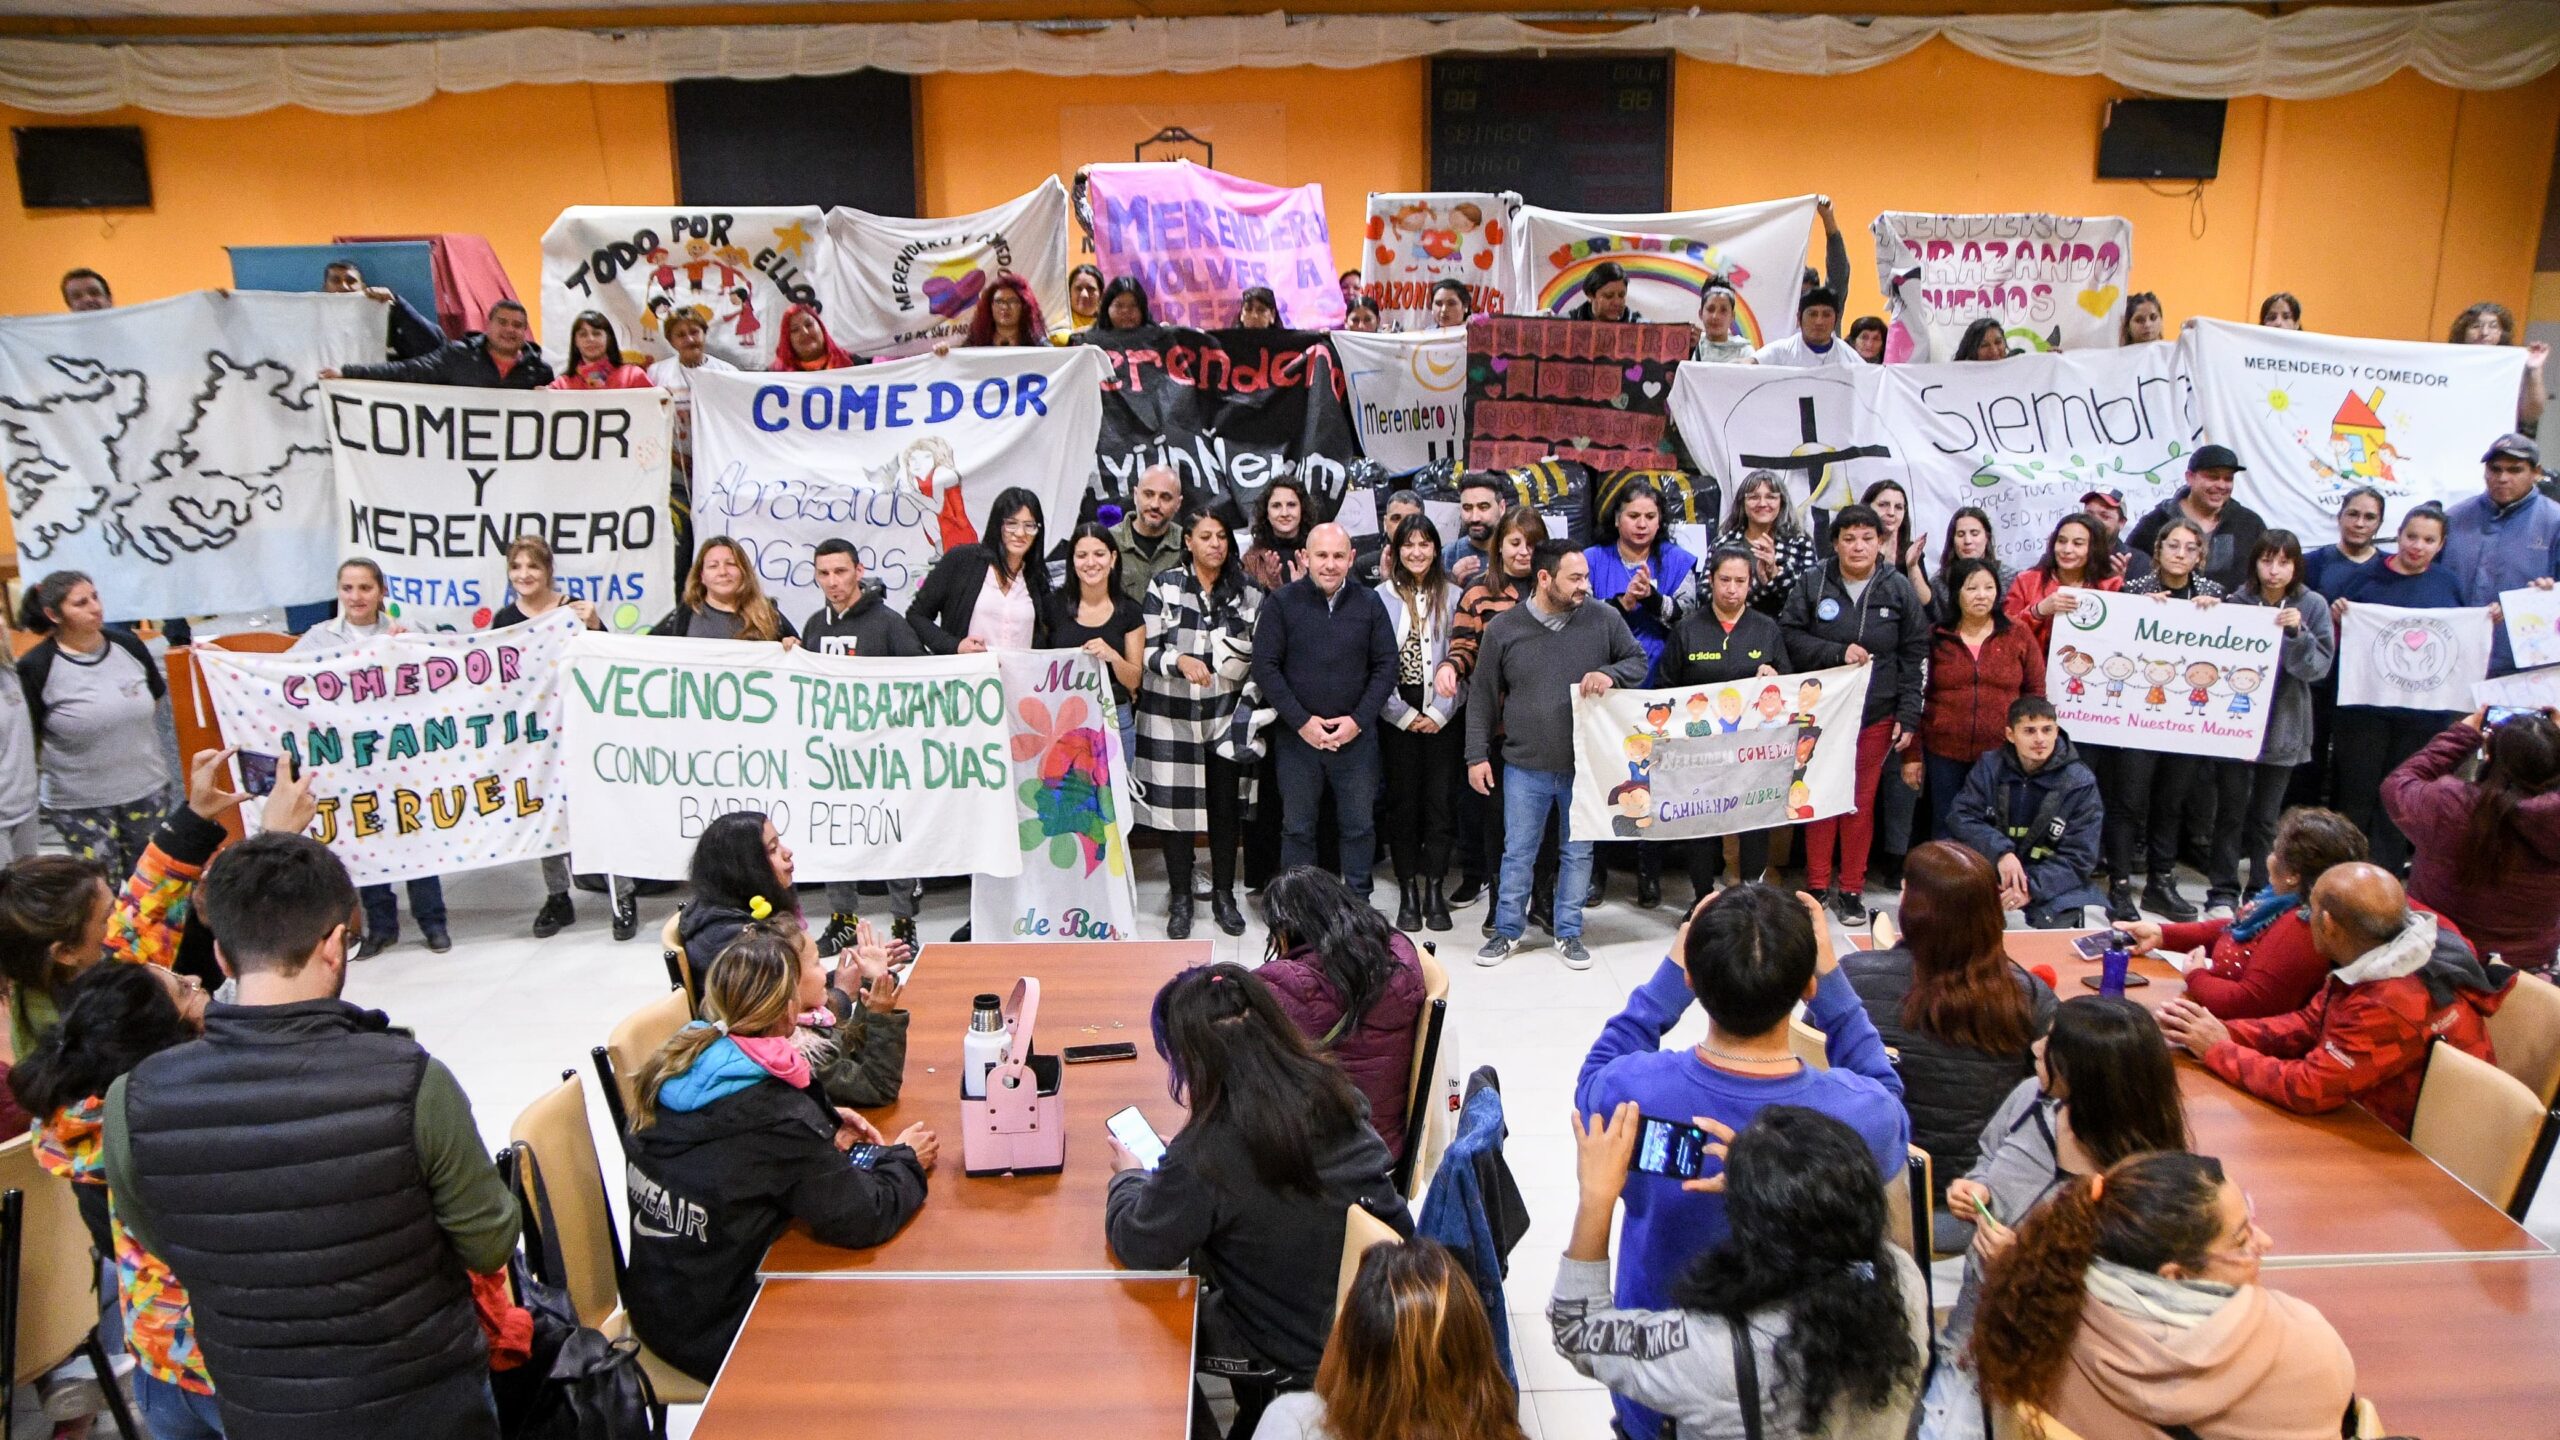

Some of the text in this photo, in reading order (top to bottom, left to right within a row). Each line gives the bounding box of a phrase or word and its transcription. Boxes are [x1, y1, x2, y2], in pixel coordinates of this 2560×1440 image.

[1105, 195, 1328, 254] MERENDERO
[564, 229, 660, 297] TODO
[670, 214, 733, 246] POR
[2244, 356, 2448, 387] MERENDERO Y COMEDOR
[330, 394, 631, 461] COMEDOR
[753, 373, 1048, 432] COMEDOR
[467, 467, 497, 507] Y
[1688, 651, 1722, 661] adidas
[2135, 618, 2272, 653] Merendero
[283, 645, 521, 708] COMEDOR
[572, 665, 1005, 732] VECINOS TRABAJANDO
[281, 711, 549, 769] INFANTIL
[805, 735, 911, 791] SILVIA
[922, 738, 1007, 791] DIAS
[310, 774, 544, 845] JERUEL
[809, 798, 902, 847] PERÓN
[1013, 908, 1051, 937] de
[655, 1190, 709, 1243] AIR
